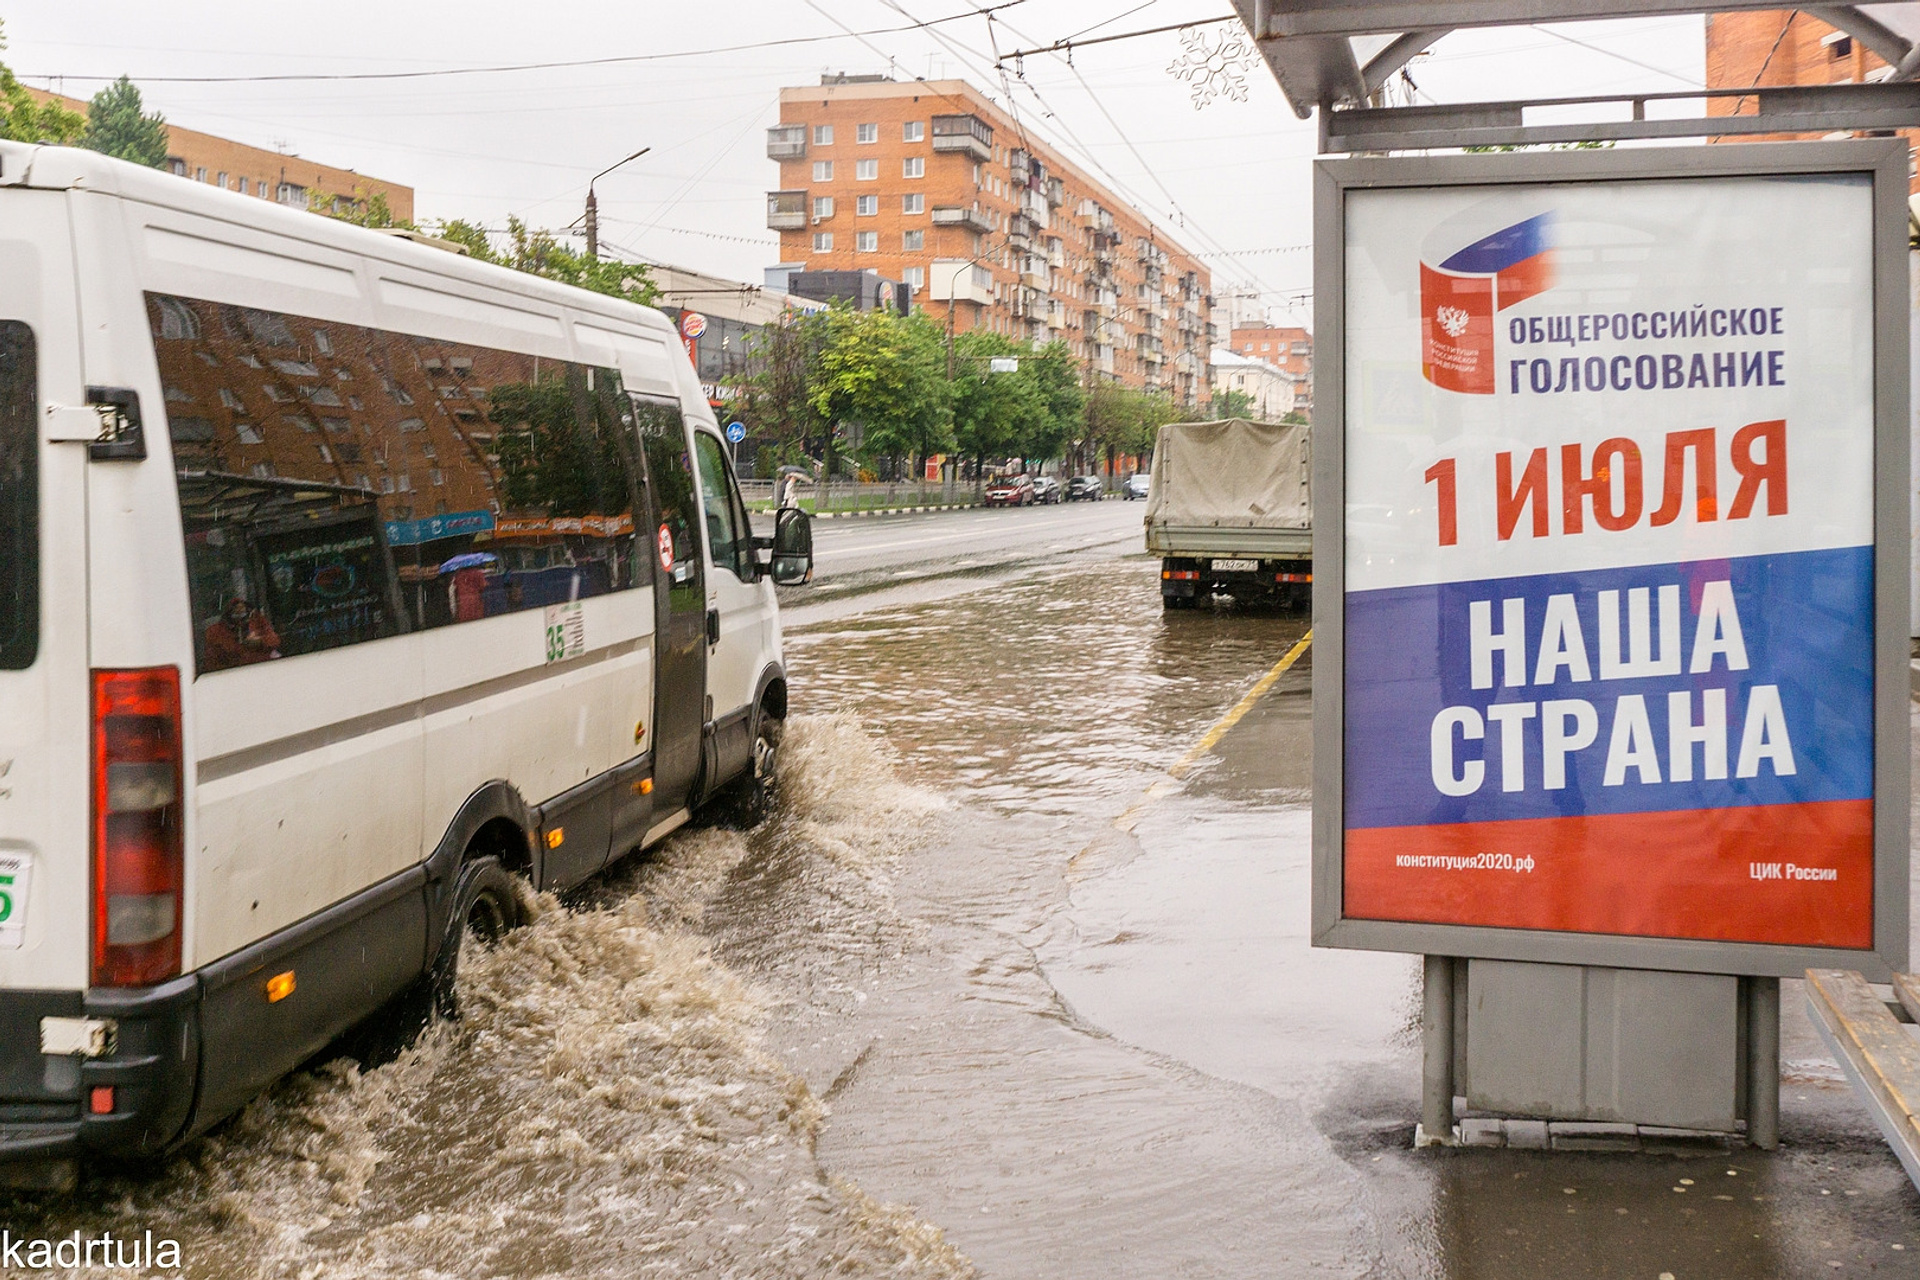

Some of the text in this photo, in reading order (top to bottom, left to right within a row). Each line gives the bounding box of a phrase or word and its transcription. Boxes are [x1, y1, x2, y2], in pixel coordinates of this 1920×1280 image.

[1510, 304, 1784, 346] ОБЩЕРОССИЙСКОЕ
[1510, 350, 1786, 394] ГОЛОСОВАНИЕ
[1425, 419, 1788, 546] 1 ИЮЛЯ
[546, 624, 565, 661] 35
[1469, 580, 1750, 690] НАША
[1430, 684, 1797, 797] СТРАНА
[1395, 853, 1535, 873] конституция2020.рф
[1750, 862, 1837, 881] ЦИК России
